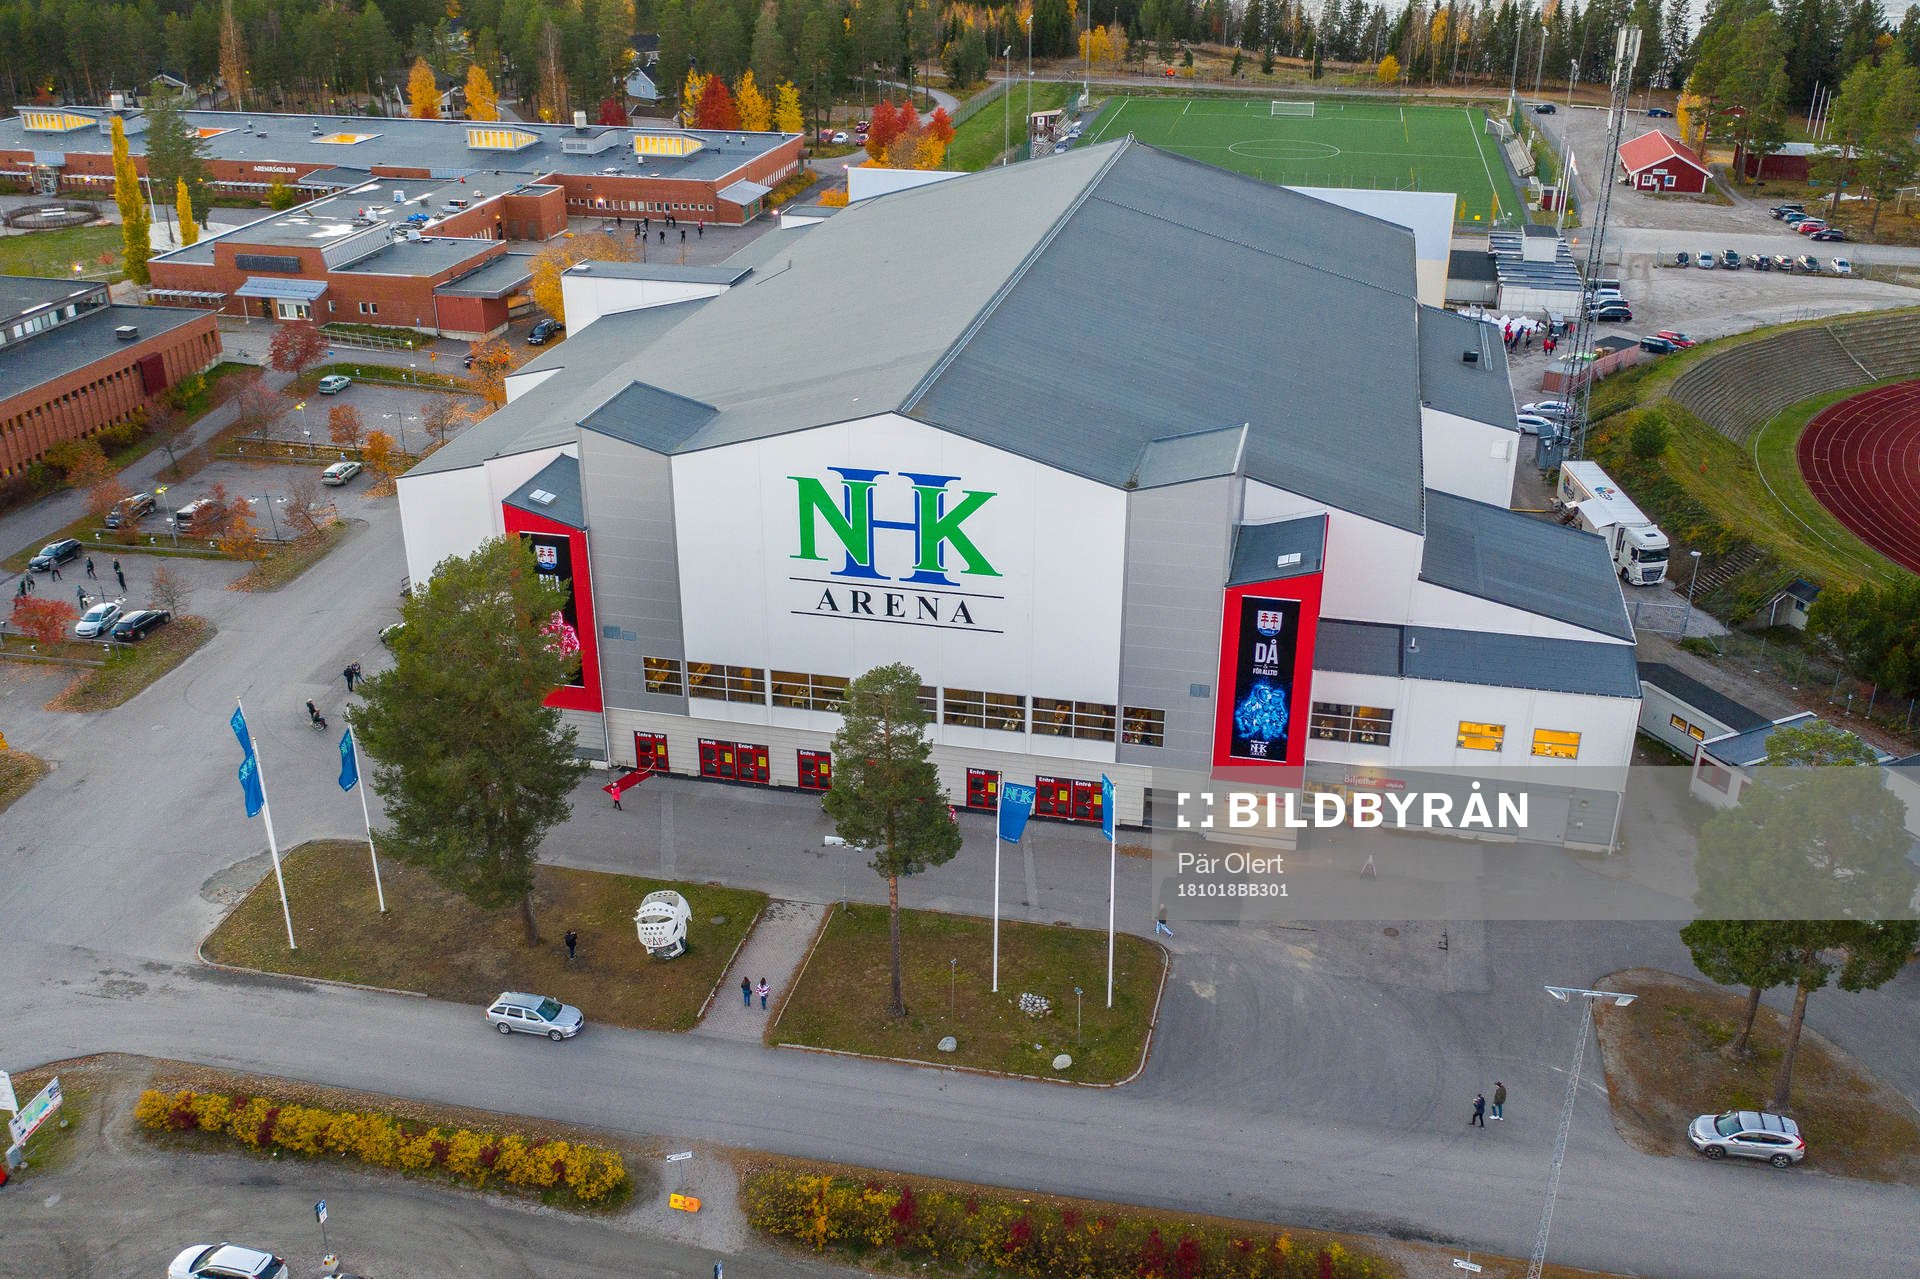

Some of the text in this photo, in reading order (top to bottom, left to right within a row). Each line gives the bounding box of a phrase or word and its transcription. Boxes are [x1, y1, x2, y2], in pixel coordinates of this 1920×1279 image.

[786, 466, 1003, 587] NHK
[815, 587, 976, 625] ARENA
[1254, 639, 1279, 665] DÅ
